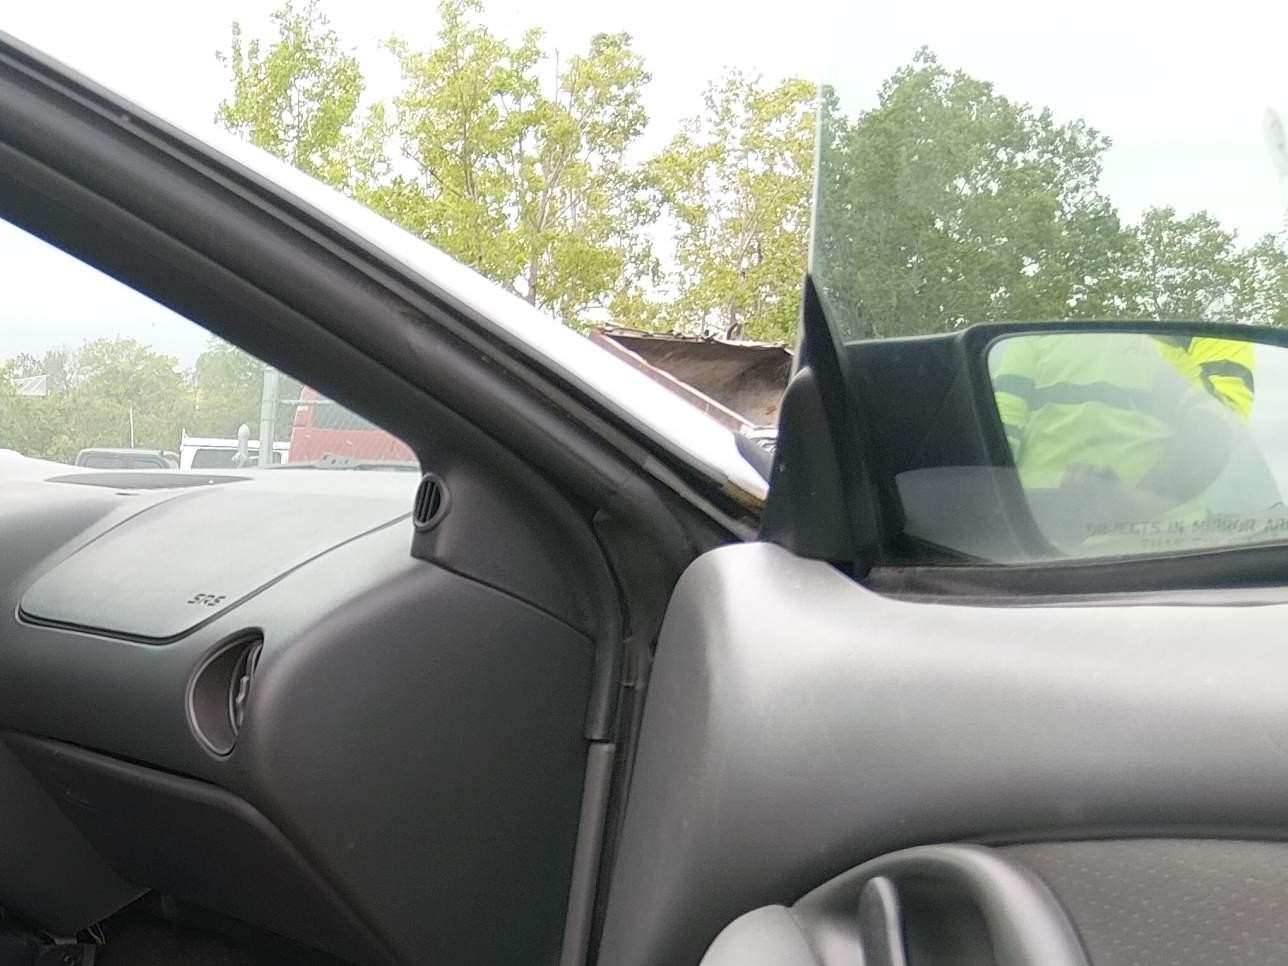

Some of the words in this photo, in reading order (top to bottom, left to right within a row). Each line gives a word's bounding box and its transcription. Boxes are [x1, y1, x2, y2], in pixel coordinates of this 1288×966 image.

[1168, 520, 1184, 534] IN
[1263, 517, 1288, 533] AR
[186, 593, 227, 607] SRS
